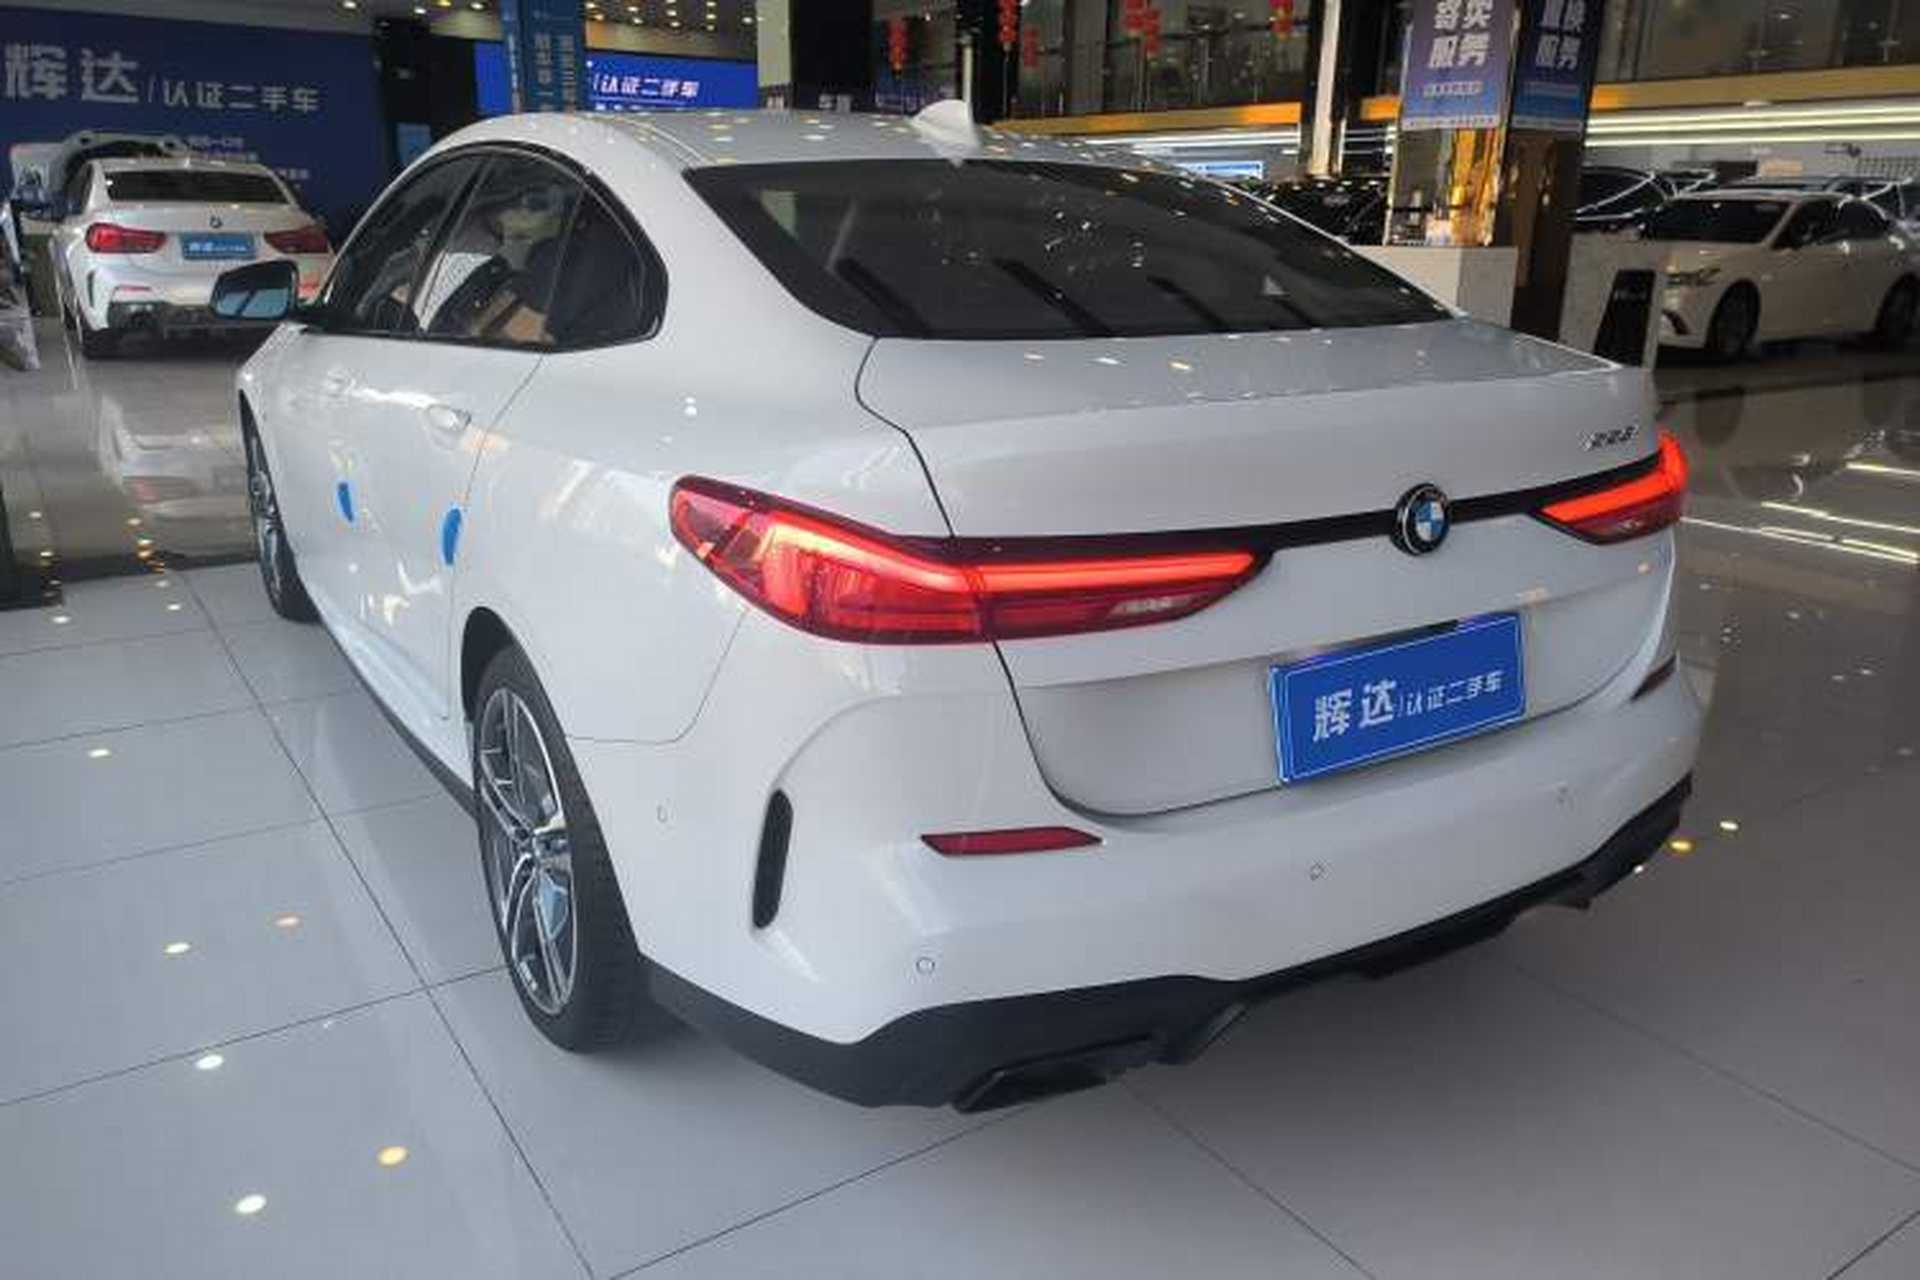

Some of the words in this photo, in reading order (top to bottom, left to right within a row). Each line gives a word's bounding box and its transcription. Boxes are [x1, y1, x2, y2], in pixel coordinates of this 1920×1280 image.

[3, 44, 139, 103] 辉达
[162, 80, 320, 113] 认证二手车
[1429, 32, 1490, 68] 服务
[1312, 679, 1397, 743] 辉达
[1406, 669, 1503, 715] 认证二手车
